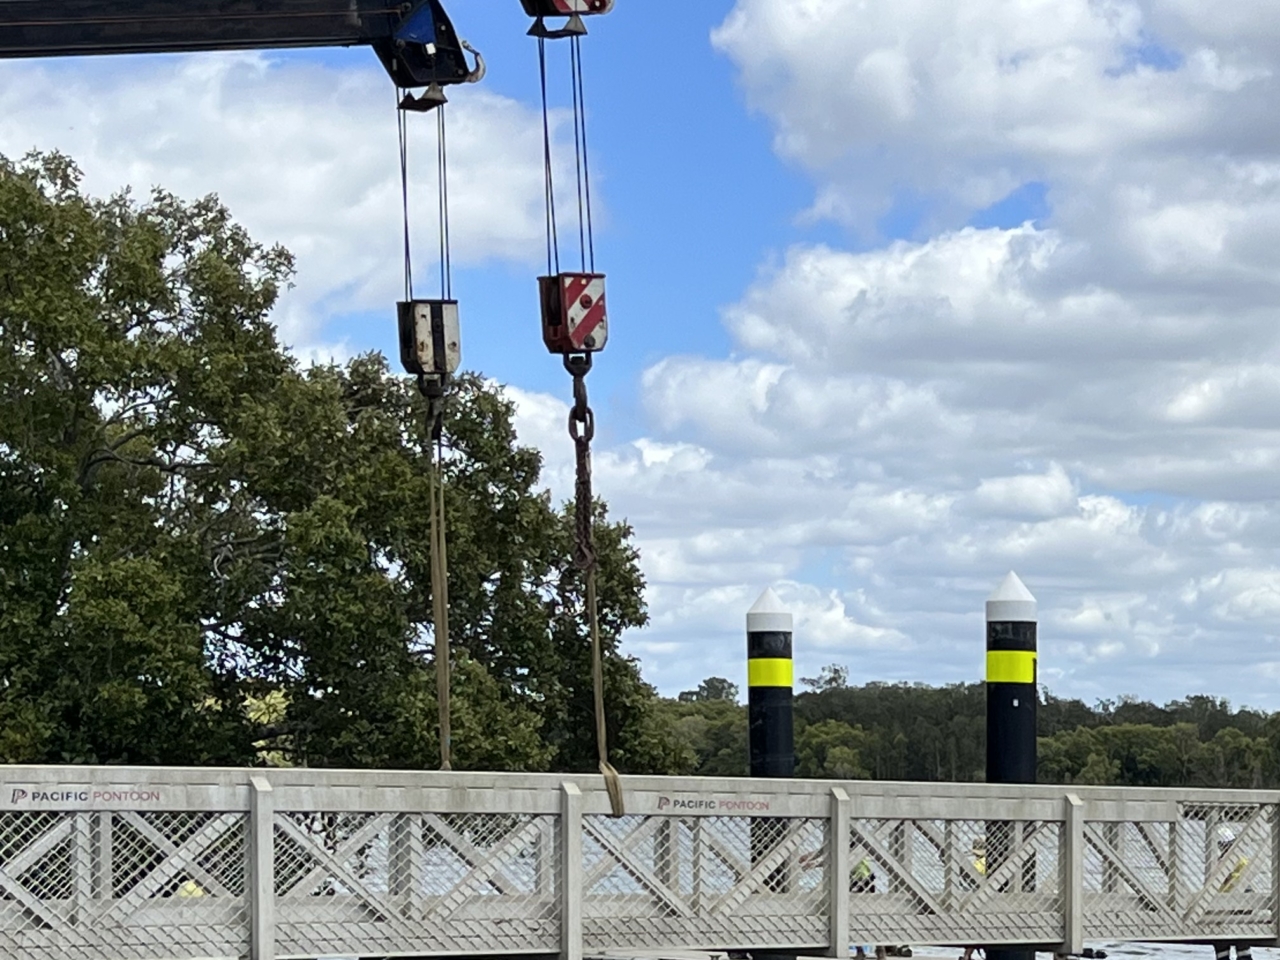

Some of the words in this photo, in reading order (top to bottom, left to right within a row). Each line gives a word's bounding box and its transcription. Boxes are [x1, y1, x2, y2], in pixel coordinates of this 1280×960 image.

[32, 791, 88, 801] PACIFIC
[93, 791, 160, 802] PONTOON
[673, 800, 716, 809] PACIFIC
[719, 800, 769, 810] PONTOON
